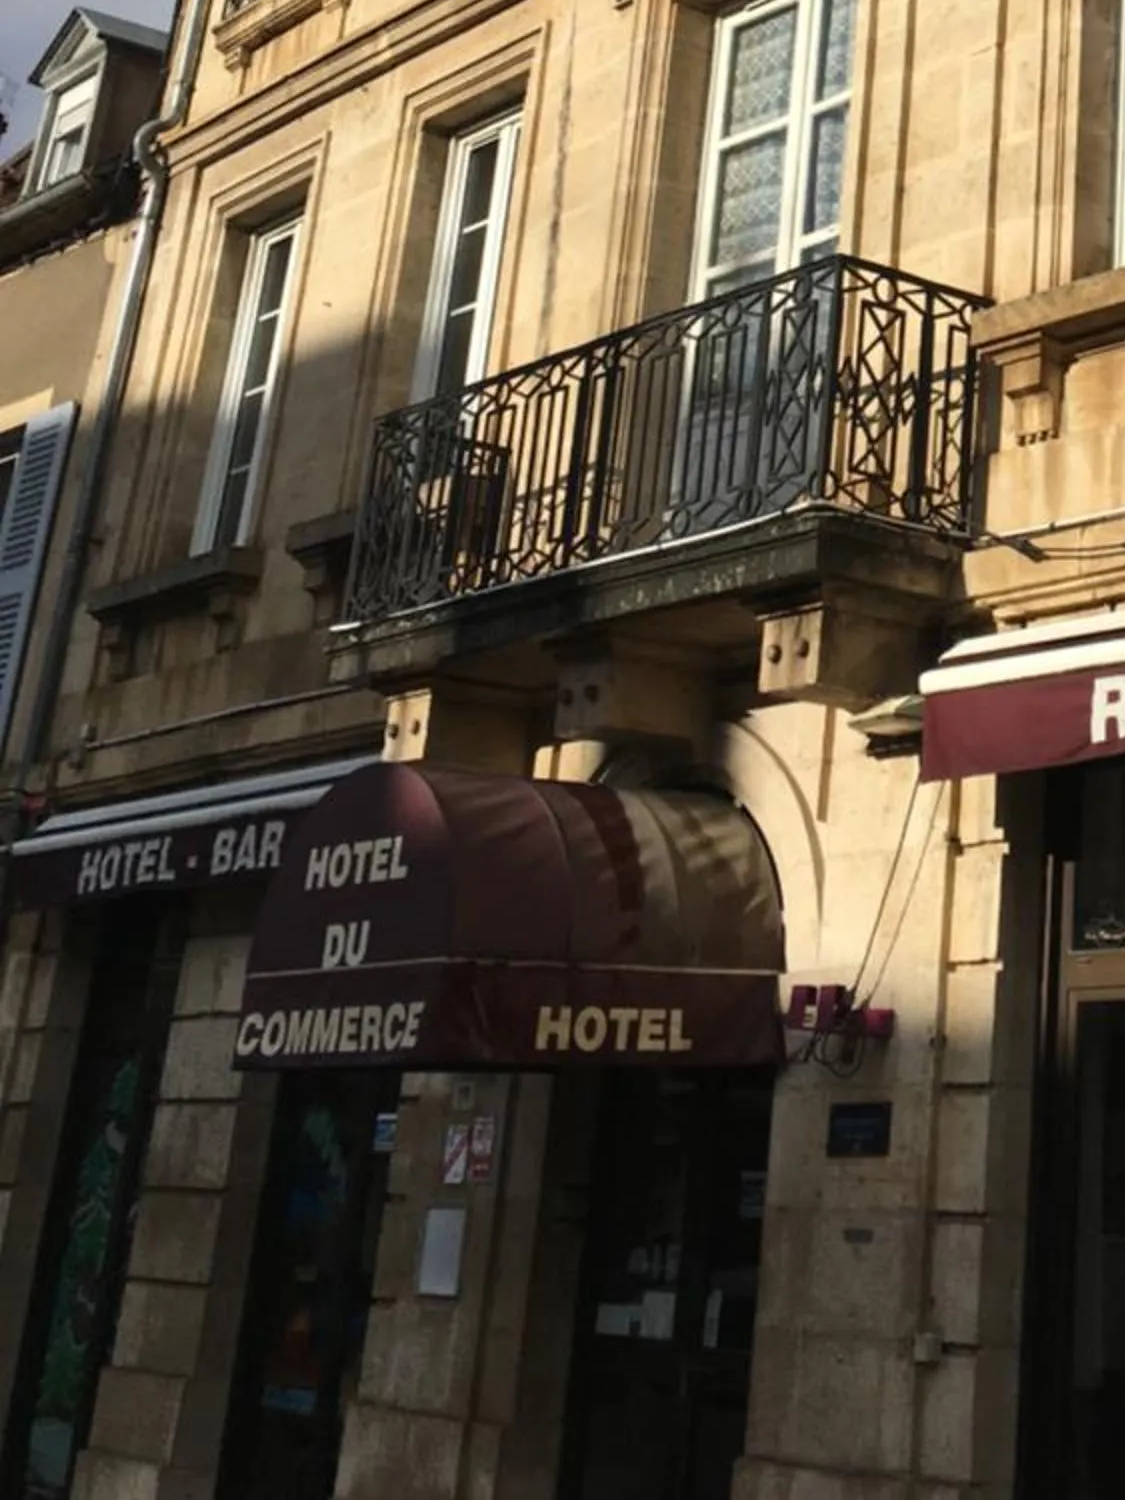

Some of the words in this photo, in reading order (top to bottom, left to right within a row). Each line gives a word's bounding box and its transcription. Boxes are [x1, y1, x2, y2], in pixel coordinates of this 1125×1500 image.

[77, 836, 176, 894] HOTEL
[210, 821, 285, 876] BAR
[304, 836, 408, 891] HOTEL
[321, 920, 371, 970] DU
[236, 1001, 425, 1057] COMMERCE
[534, 1005, 694, 1052] HOTEL
